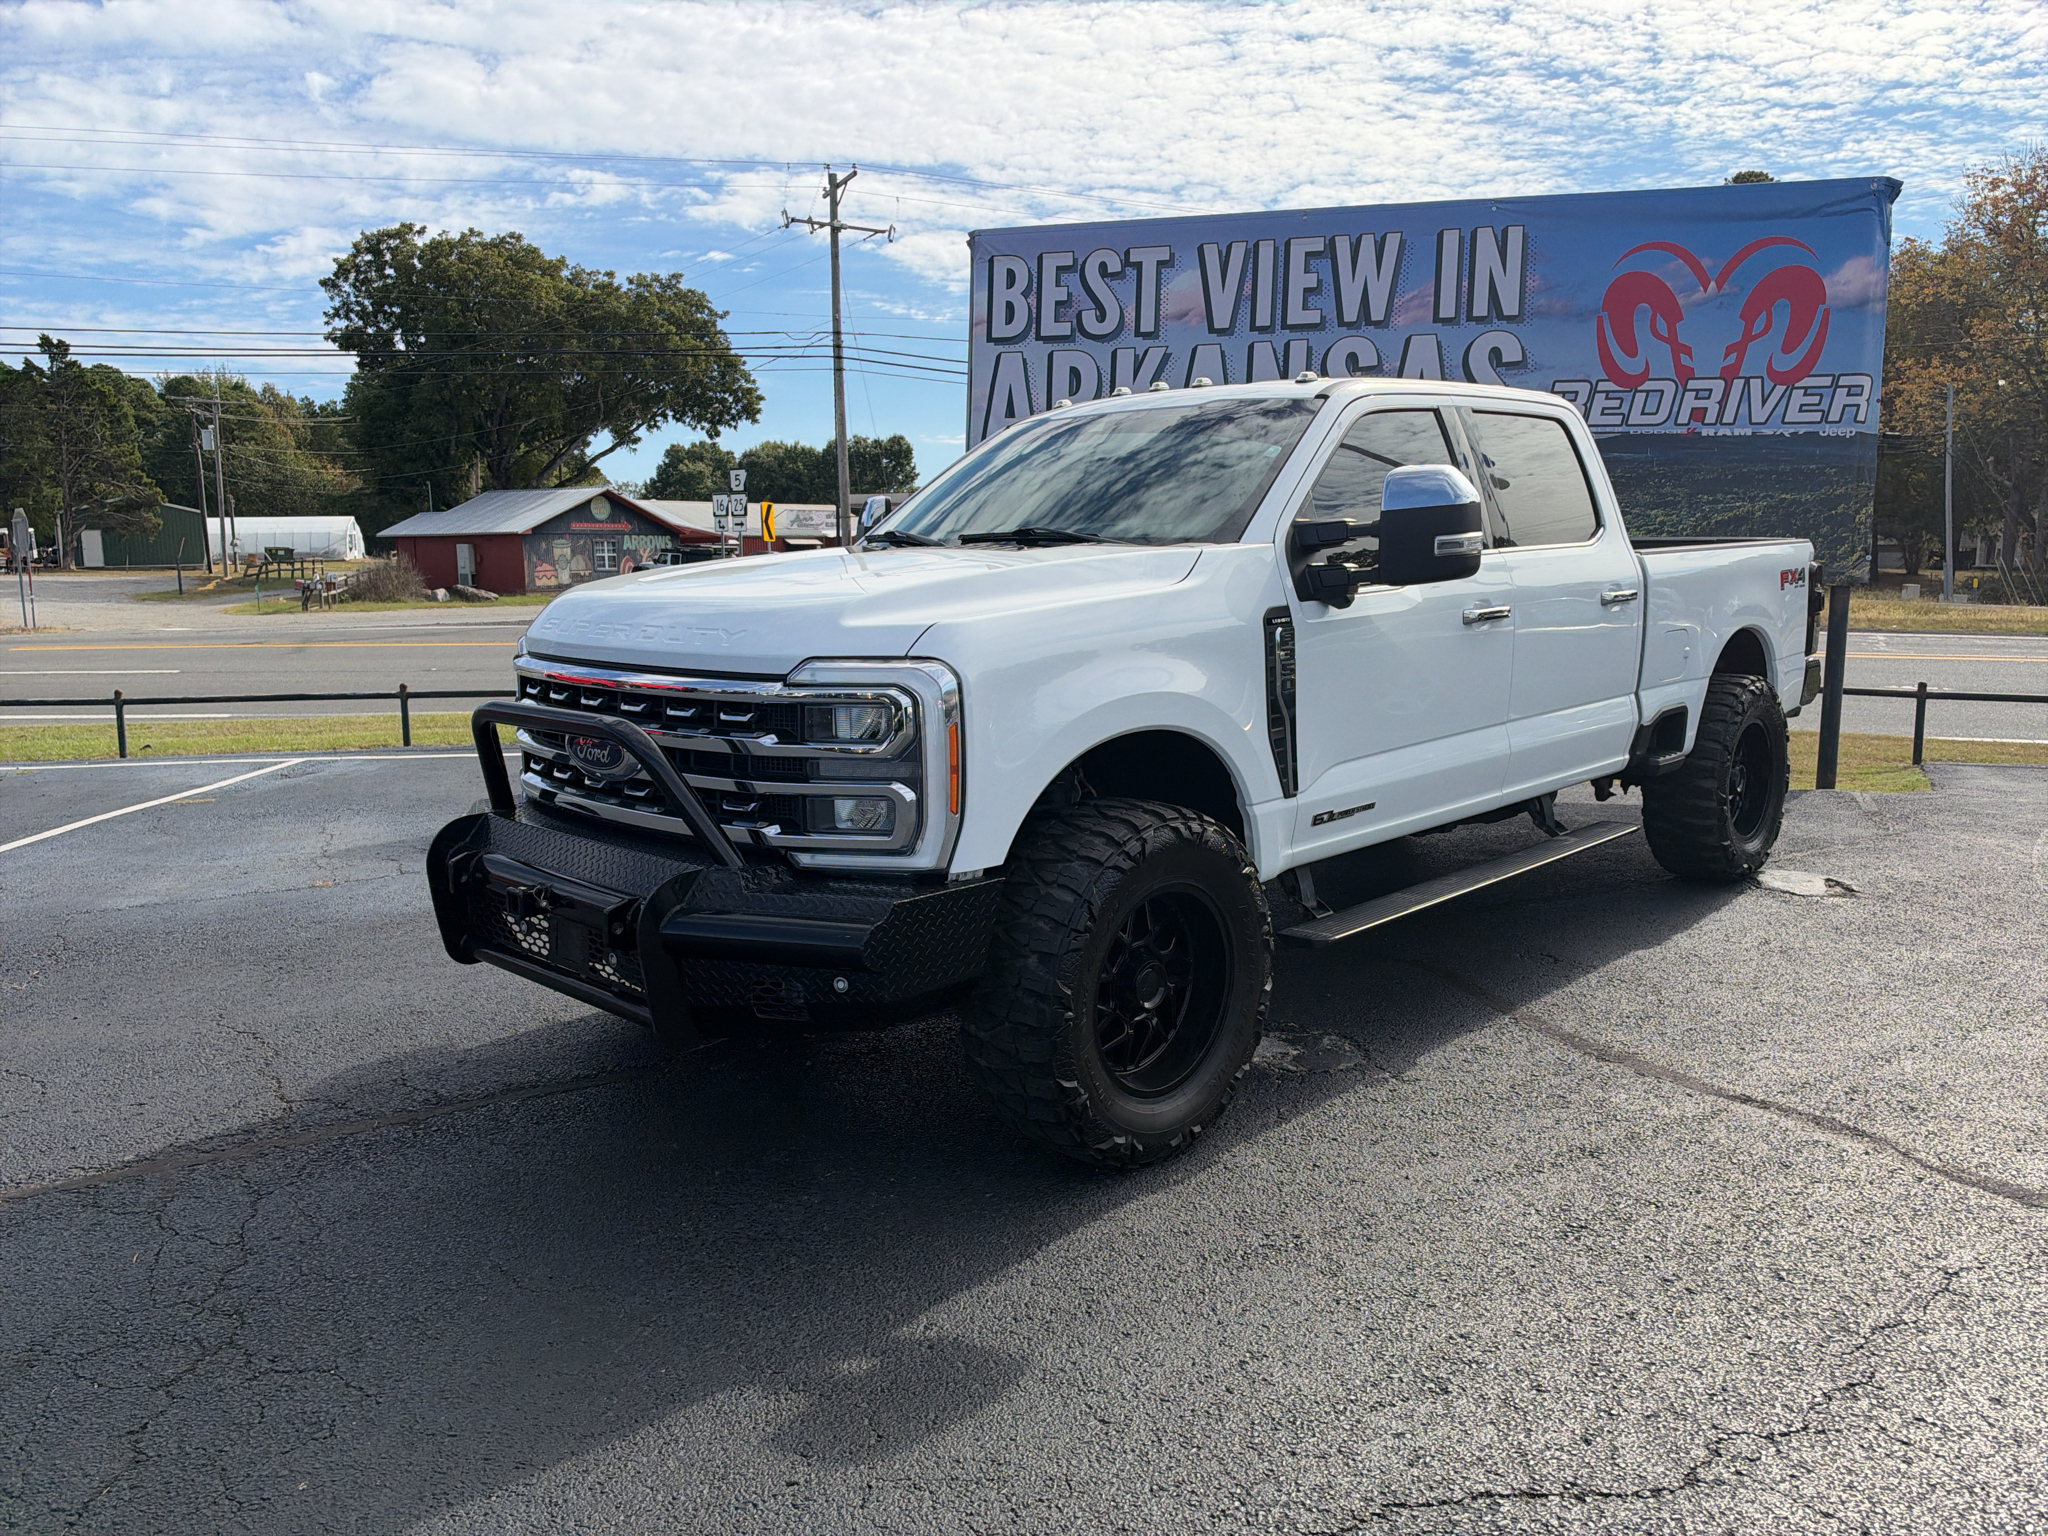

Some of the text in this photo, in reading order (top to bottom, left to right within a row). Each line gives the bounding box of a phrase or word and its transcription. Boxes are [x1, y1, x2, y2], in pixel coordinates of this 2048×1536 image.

[986, 225, 1525, 343] BEST VIEW IN
[1551, 374, 1874, 427] REDRIVER
[1701, 427, 1752, 437] RAM
[1756, 428, 1814, 438] SRT
[1819, 425, 1857, 439] Jeep
[734, 474, 741, 487] 5
[716, 499, 725, 512] 16
[734, 499, 744, 512] 25
[623, 534, 673, 551] ARROWS
[1780, 567, 1806, 591] FX4
[541, 617, 748, 647] SUPER DUTY
[577, 736, 611, 764] Ford
